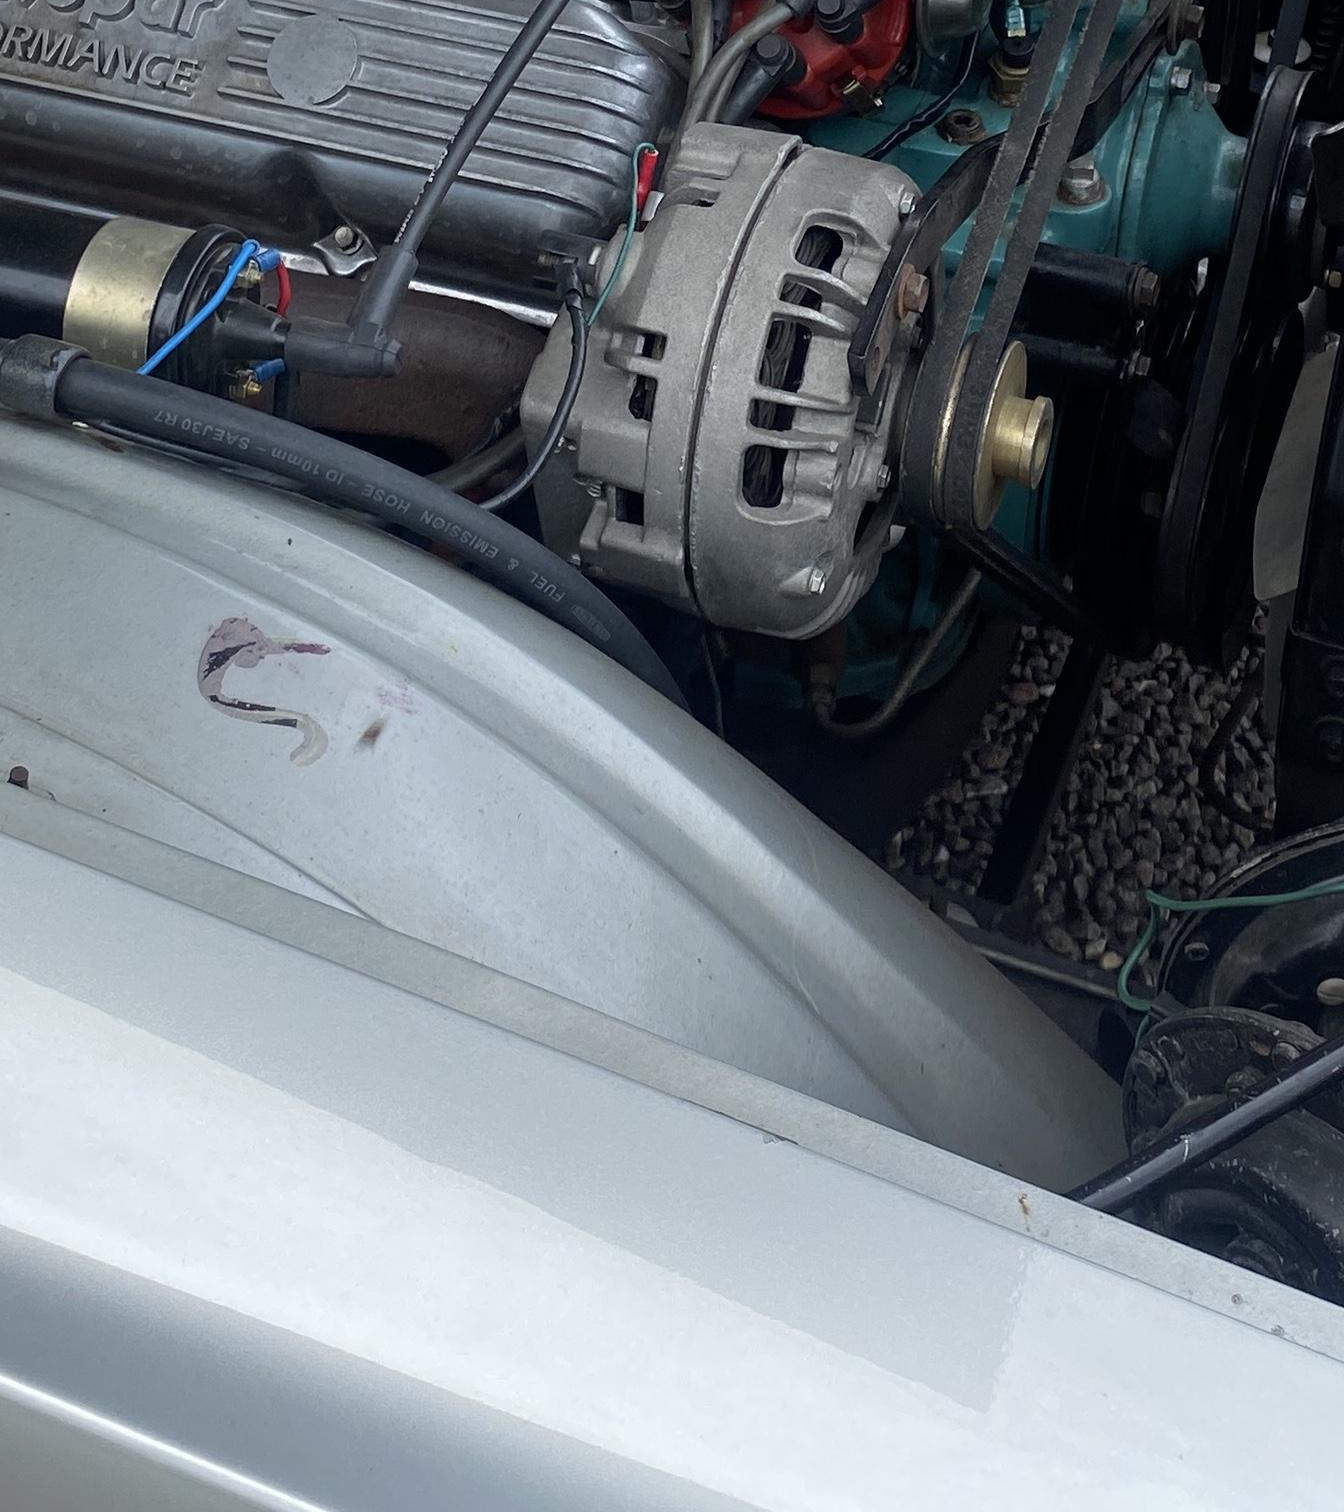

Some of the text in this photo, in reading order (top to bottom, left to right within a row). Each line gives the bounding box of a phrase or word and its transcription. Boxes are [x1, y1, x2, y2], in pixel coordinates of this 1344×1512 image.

[154, 409, 178, 426] R7
[181, 416, 251, 451] SAEJ30
[271, 446, 321, 476] 10mm
[325, 468, 345, 486] ID
[360, 483, 412, 514] HOSE
[419, 509, 499, 560] EMISSION
[507, 557, 519, 571] &
[528, 570, 566, 603] FUEL
